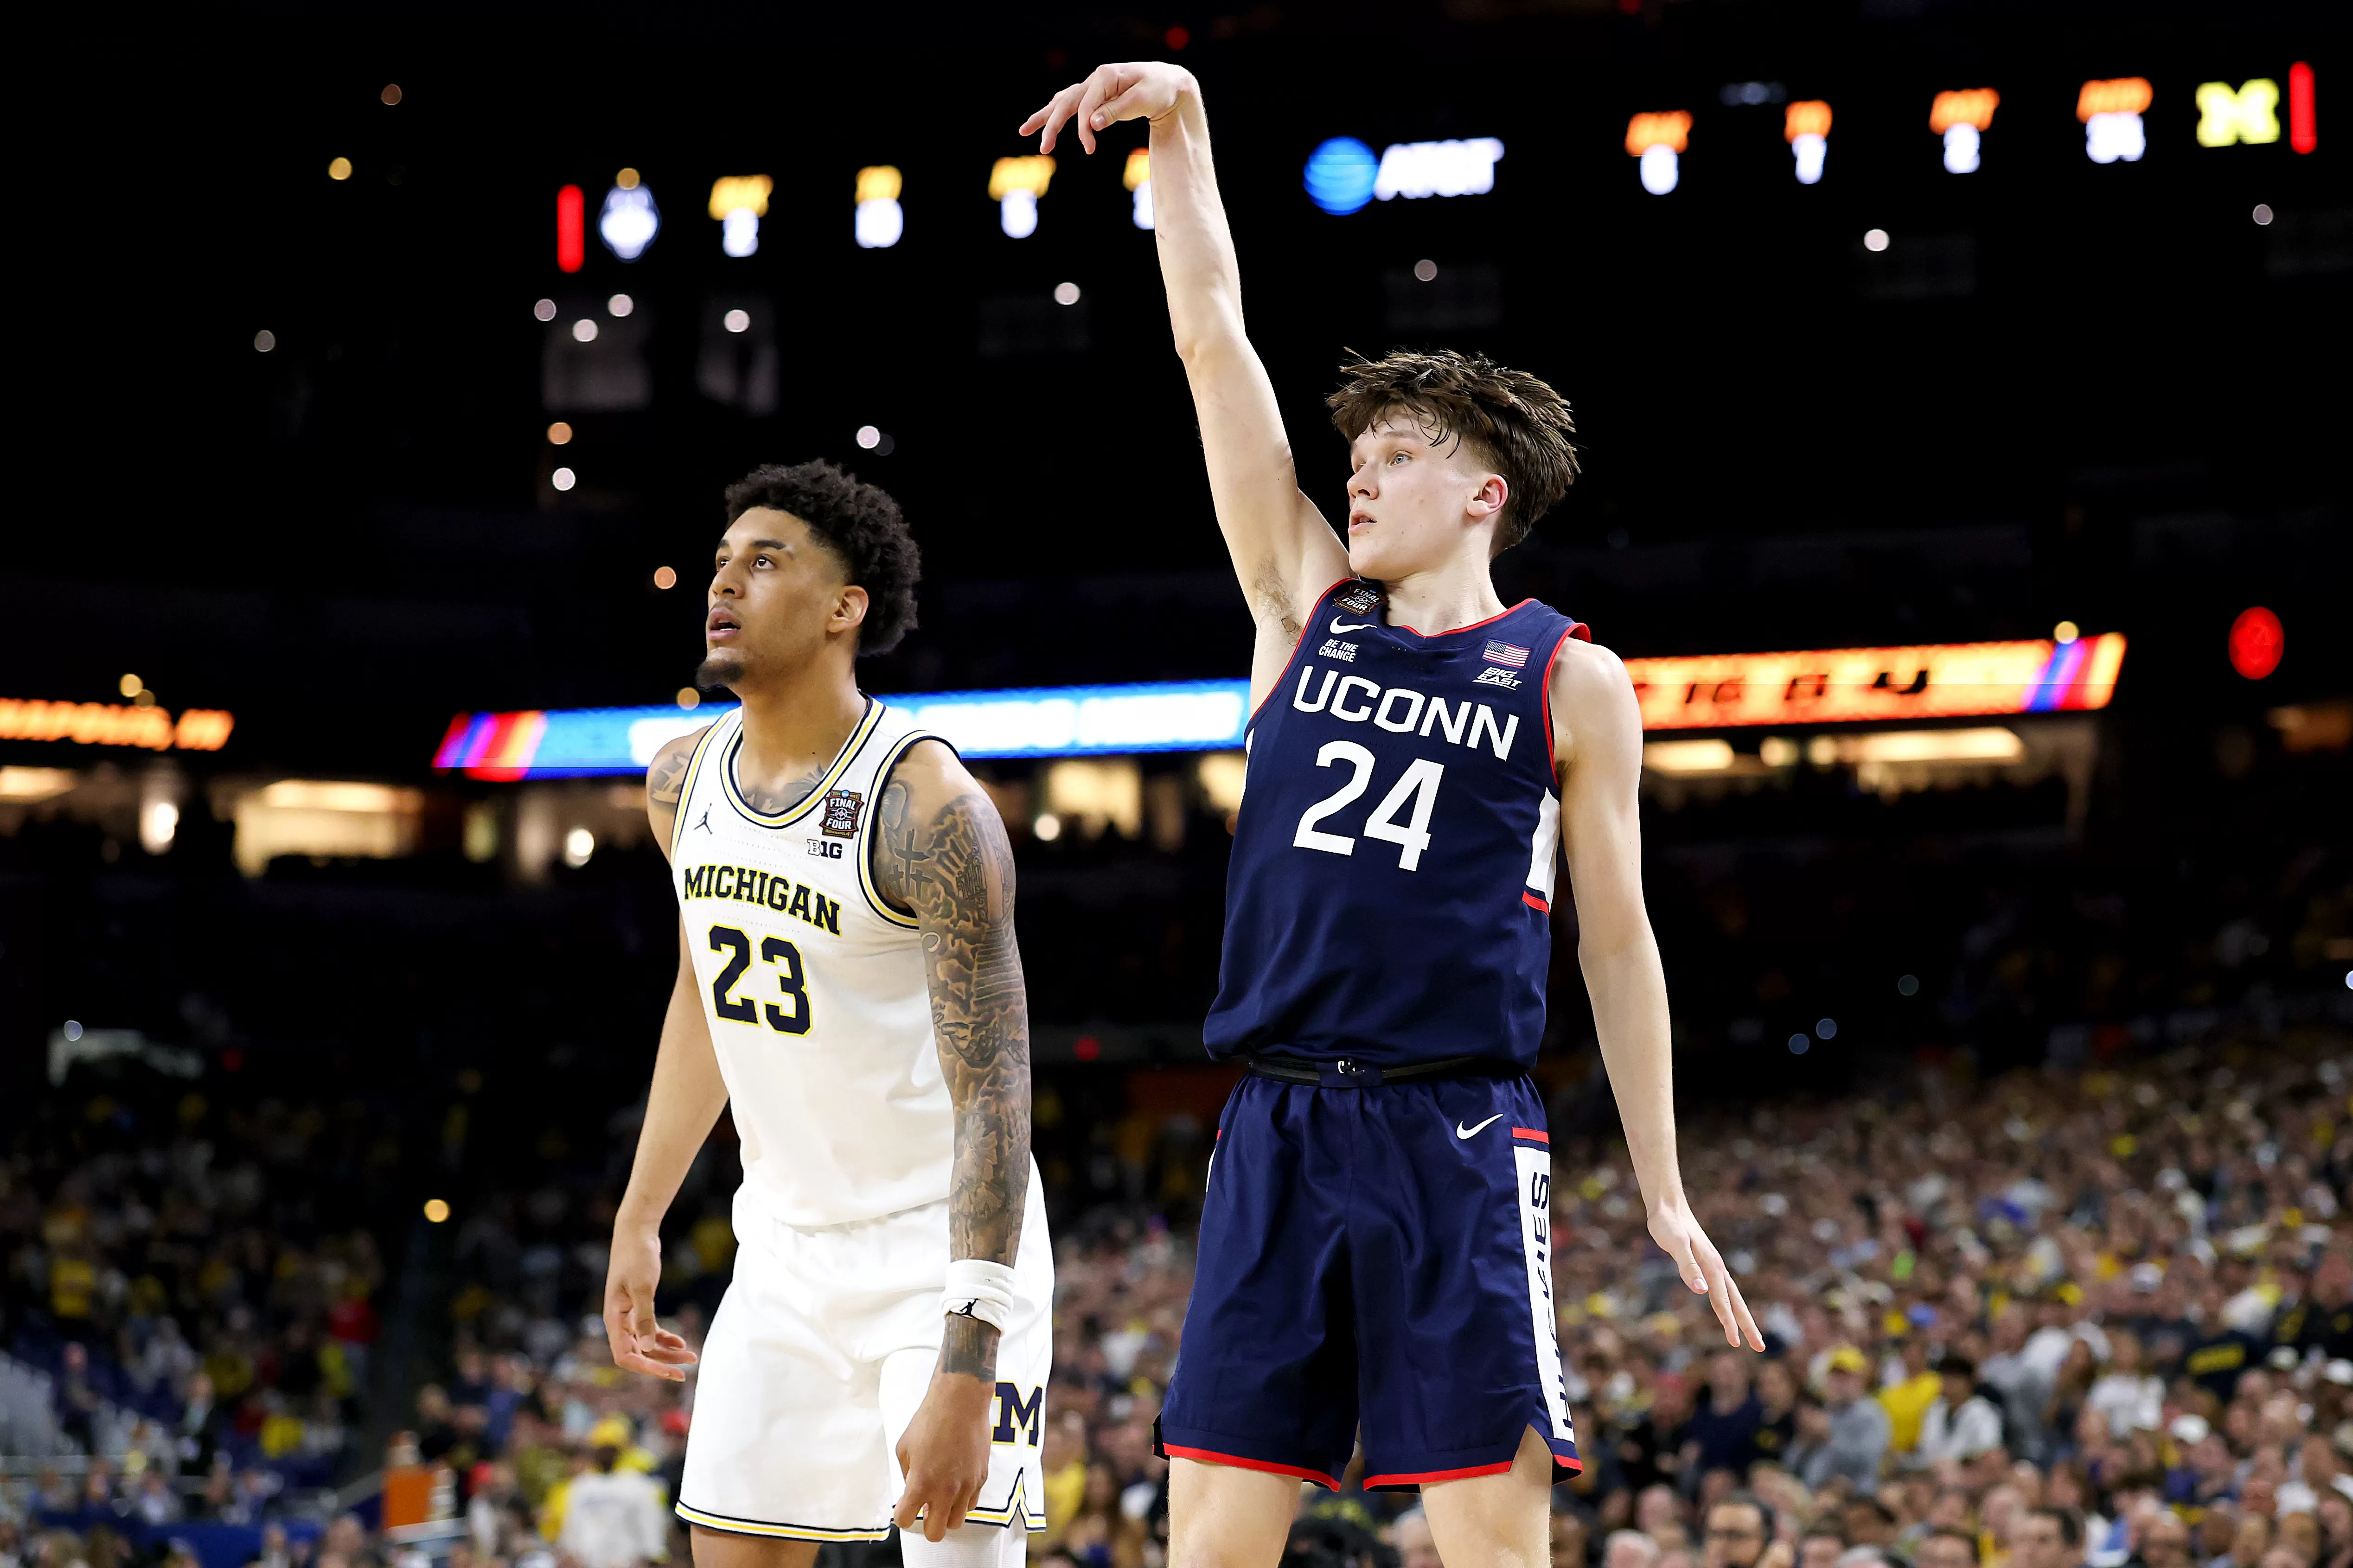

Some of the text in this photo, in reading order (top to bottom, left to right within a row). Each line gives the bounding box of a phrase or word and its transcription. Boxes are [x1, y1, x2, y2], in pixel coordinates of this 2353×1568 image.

[1353, 588, 1380, 603] FINAL
[1342, 597, 1368, 611] FOUR
[1325, 639, 1359, 653] BE THE
[1318, 646, 1356, 663] CHANGE
[1477, 673, 1522, 687] EAST
[1483, 667, 1518, 678] BIG
[1292, 665, 1519, 762] UCONN
[830, 798, 856, 810] FINAL
[1292, 740, 1445, 872] 24
[826, 817, 851, 829] FOUR
[684, 865, 842, 937] MICHIGAN
[709, 924, 813, 1037] 23
[991, 1380, 1042, 1449] M
